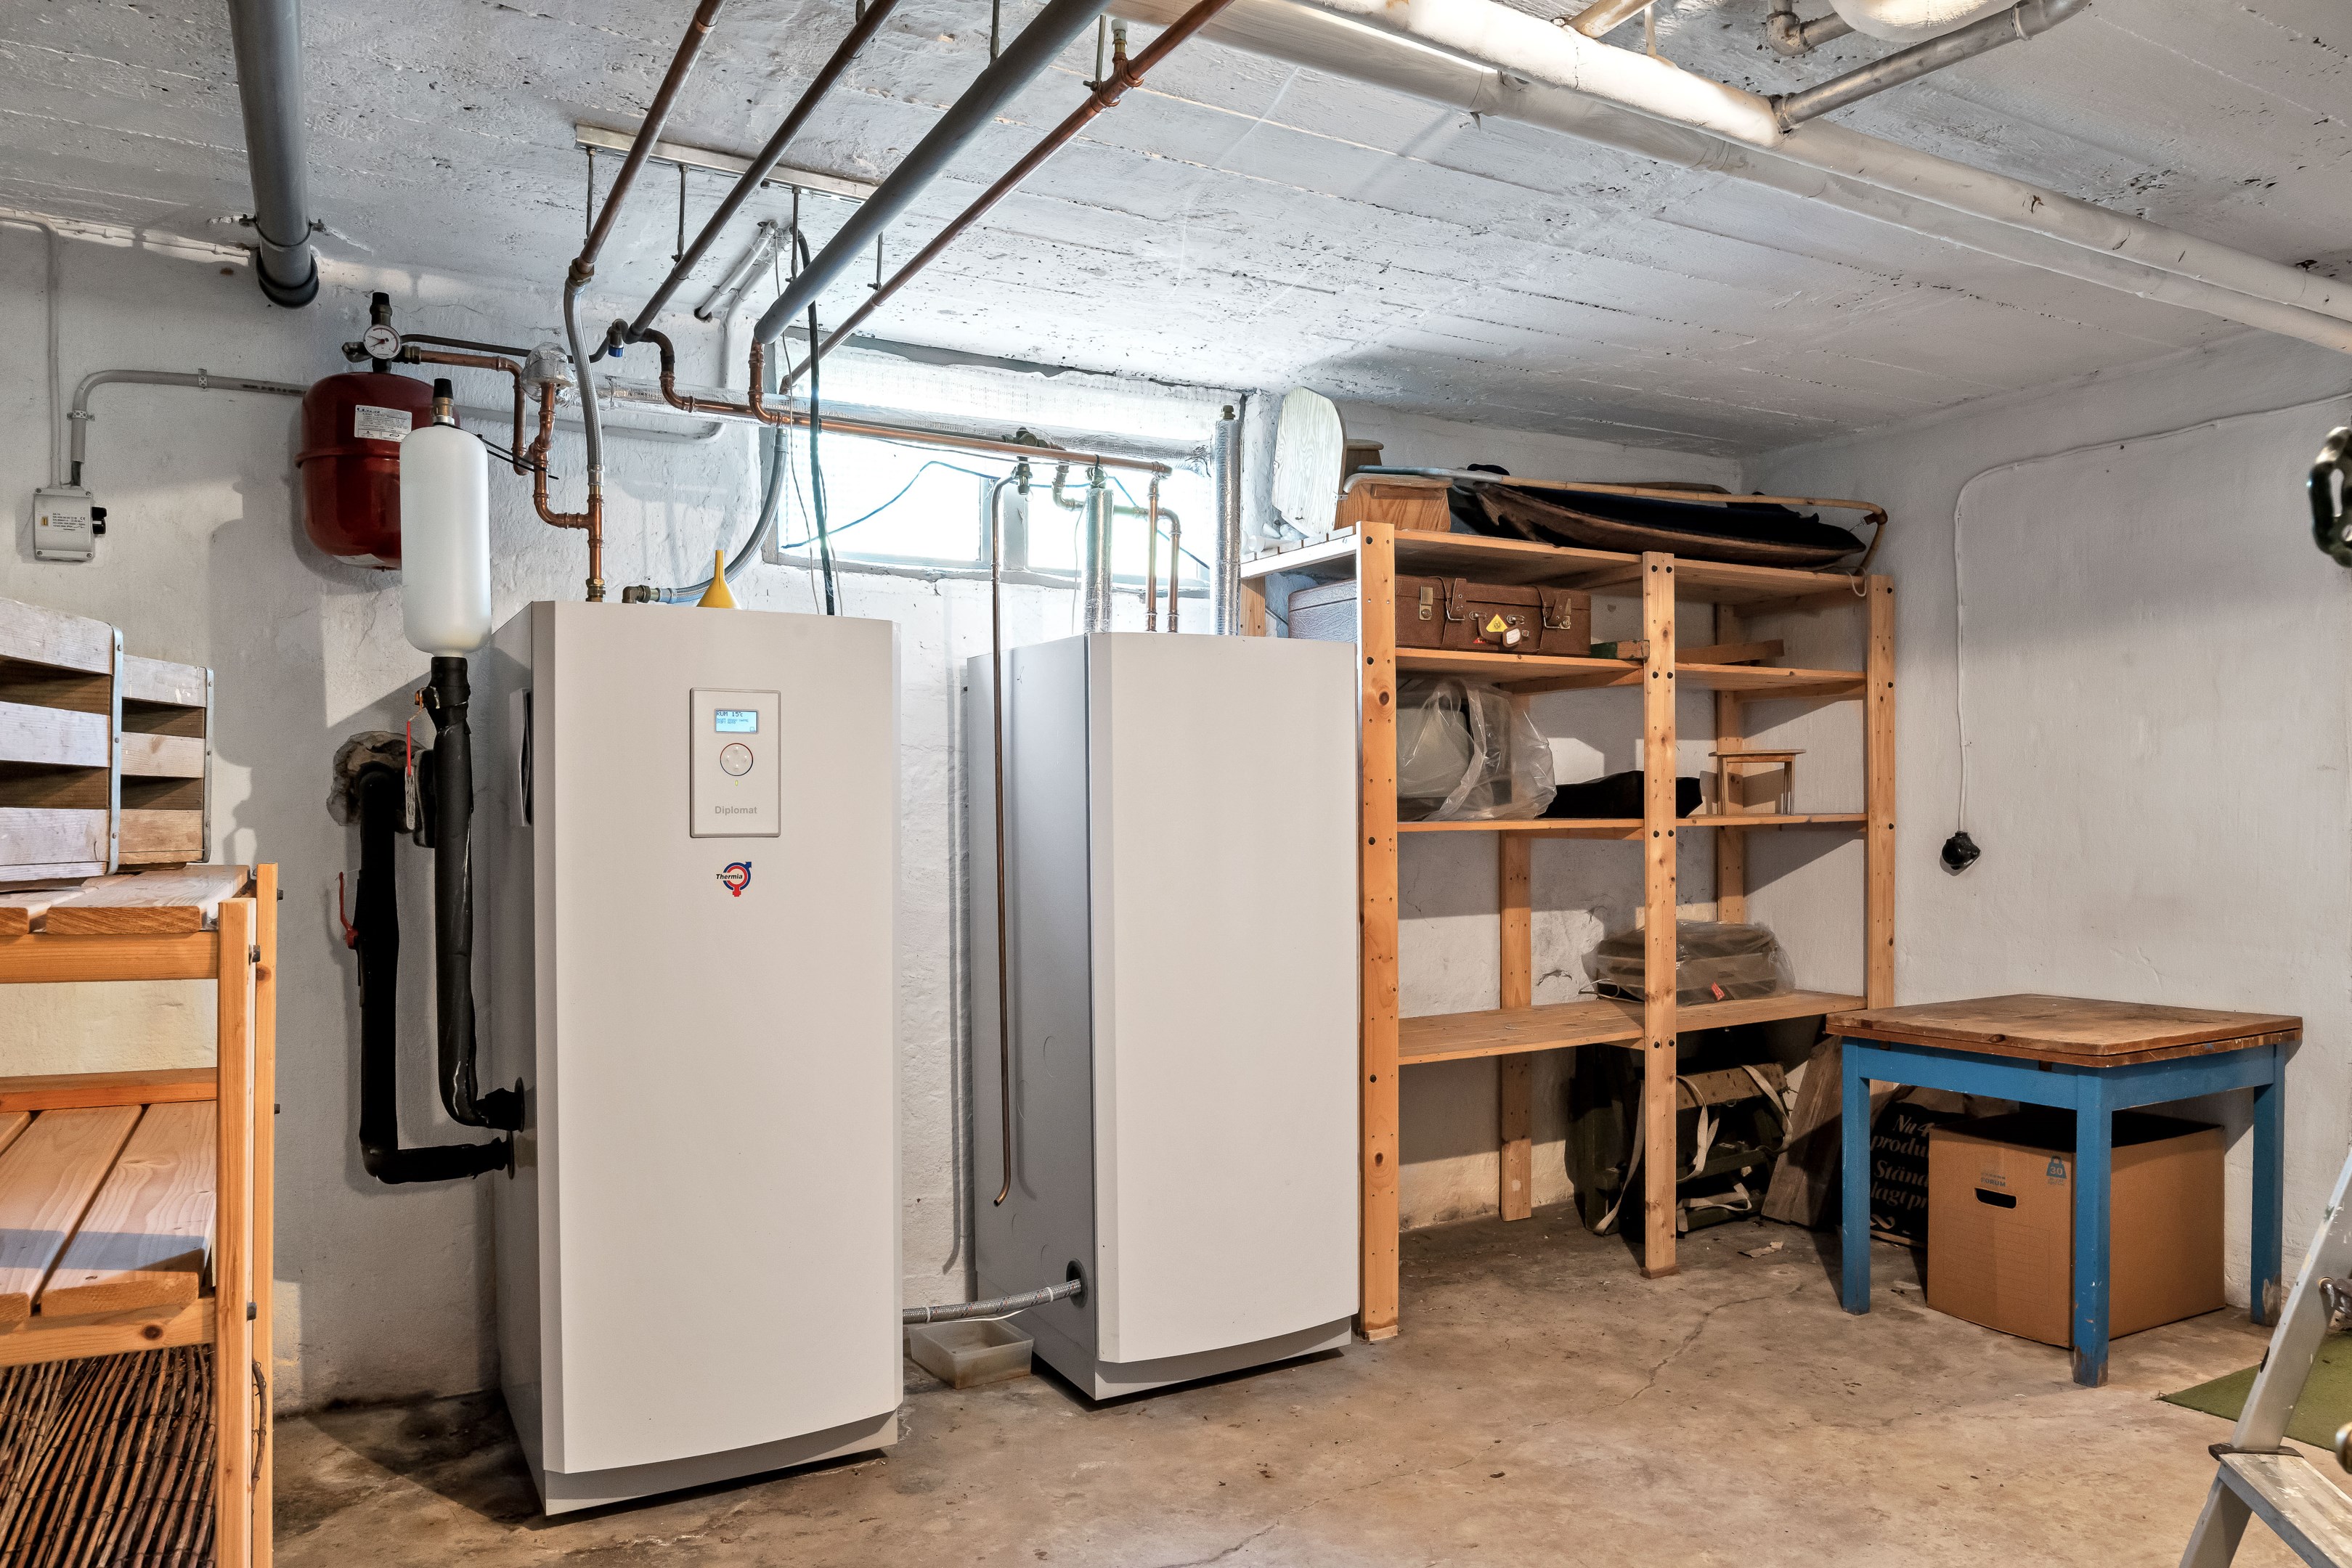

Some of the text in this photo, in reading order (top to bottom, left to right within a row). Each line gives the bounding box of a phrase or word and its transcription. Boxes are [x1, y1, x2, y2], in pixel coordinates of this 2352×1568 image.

[715, 806, 757, 816] Diplomat
[1892, 1114, 1917, 1135] Nu
[1870, 1135, 1929, 1158] produ
[2050, 1166, 2063, 1175] 30
[1980, 1177, 2006, 1188] FORUM
